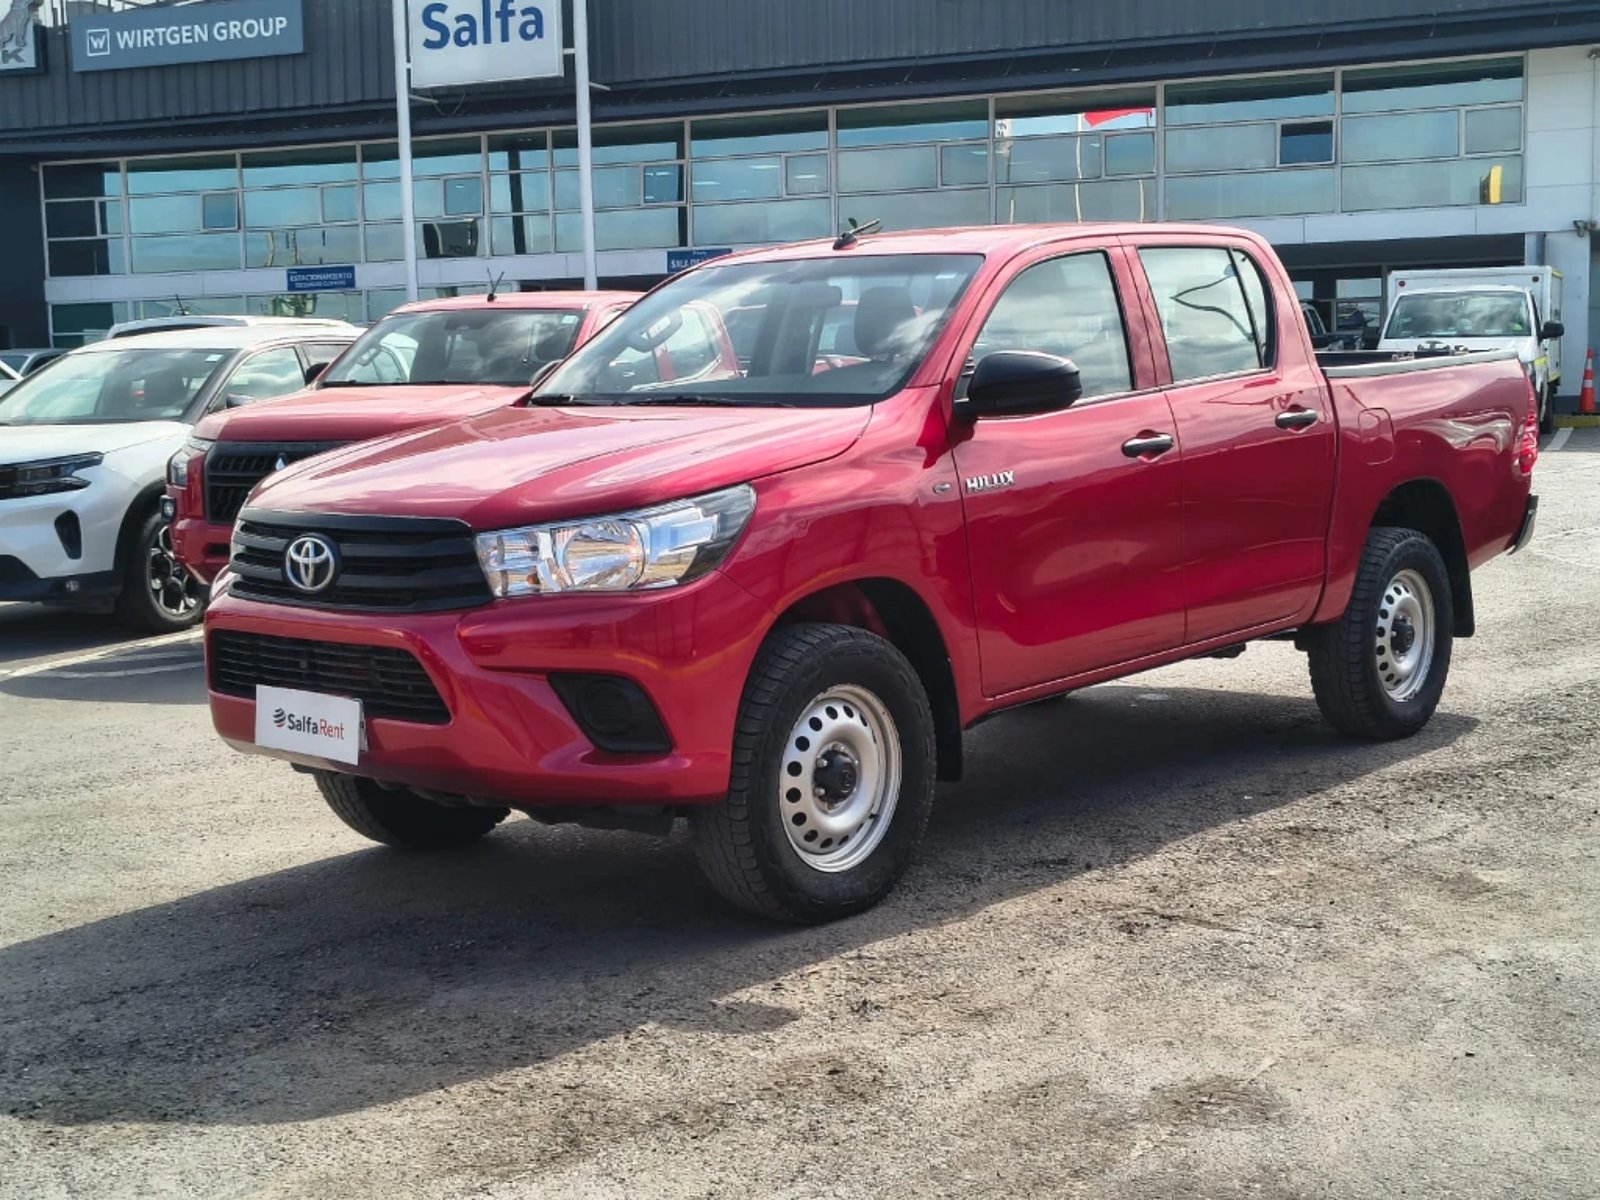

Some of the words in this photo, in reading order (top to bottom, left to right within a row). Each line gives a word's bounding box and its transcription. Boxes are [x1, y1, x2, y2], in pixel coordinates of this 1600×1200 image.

[116, 23, 209, 49] WIRTGEN
[213, 16, 288, 41] GROUP
[422, 0, 544, 49] Salfa
[287, 713, 344, 740] SalfaRent
